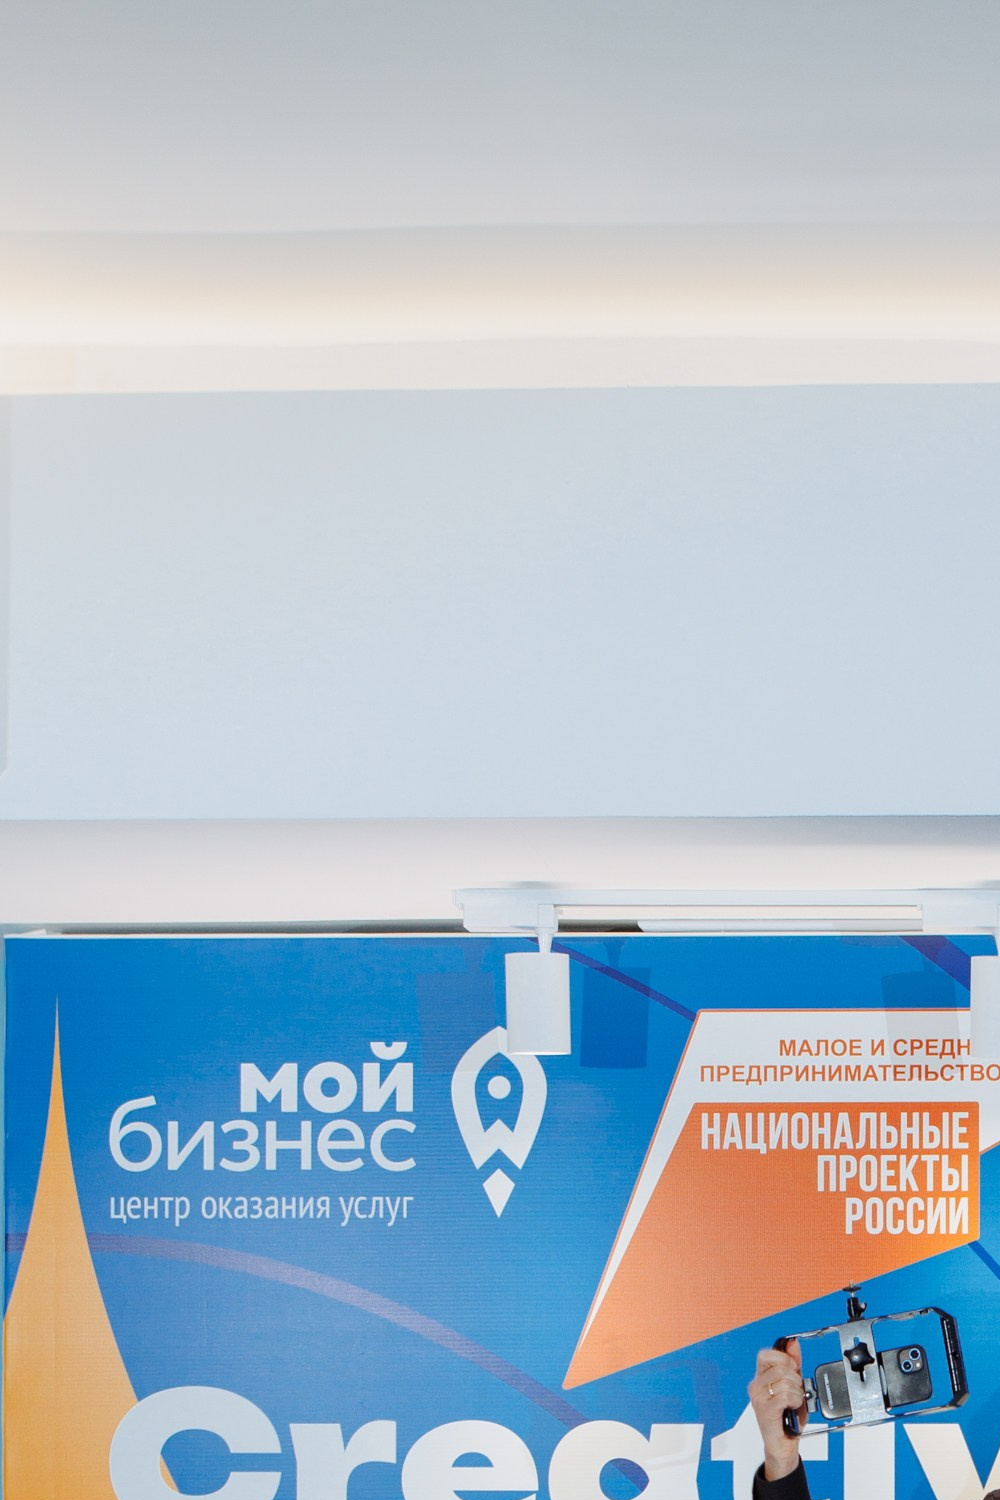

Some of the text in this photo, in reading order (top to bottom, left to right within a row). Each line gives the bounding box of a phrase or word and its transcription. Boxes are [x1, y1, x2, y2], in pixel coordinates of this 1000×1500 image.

[779, 1038, 971, 1059] МАЛОЕ И СРЕДН
[240, 1041, 414, 1113] мой
[109, 1095, 417, 1173] бизнес
[701, 1111, 969, 1155] НАЦИОНАЛЬНЫЕ
[817, 1155, 969, 1193] ПРОЕКТЫ
[110, 1195, 414, 1226] центр оказания услуг
[845, 1196, 969, 1236] РОССИИ
